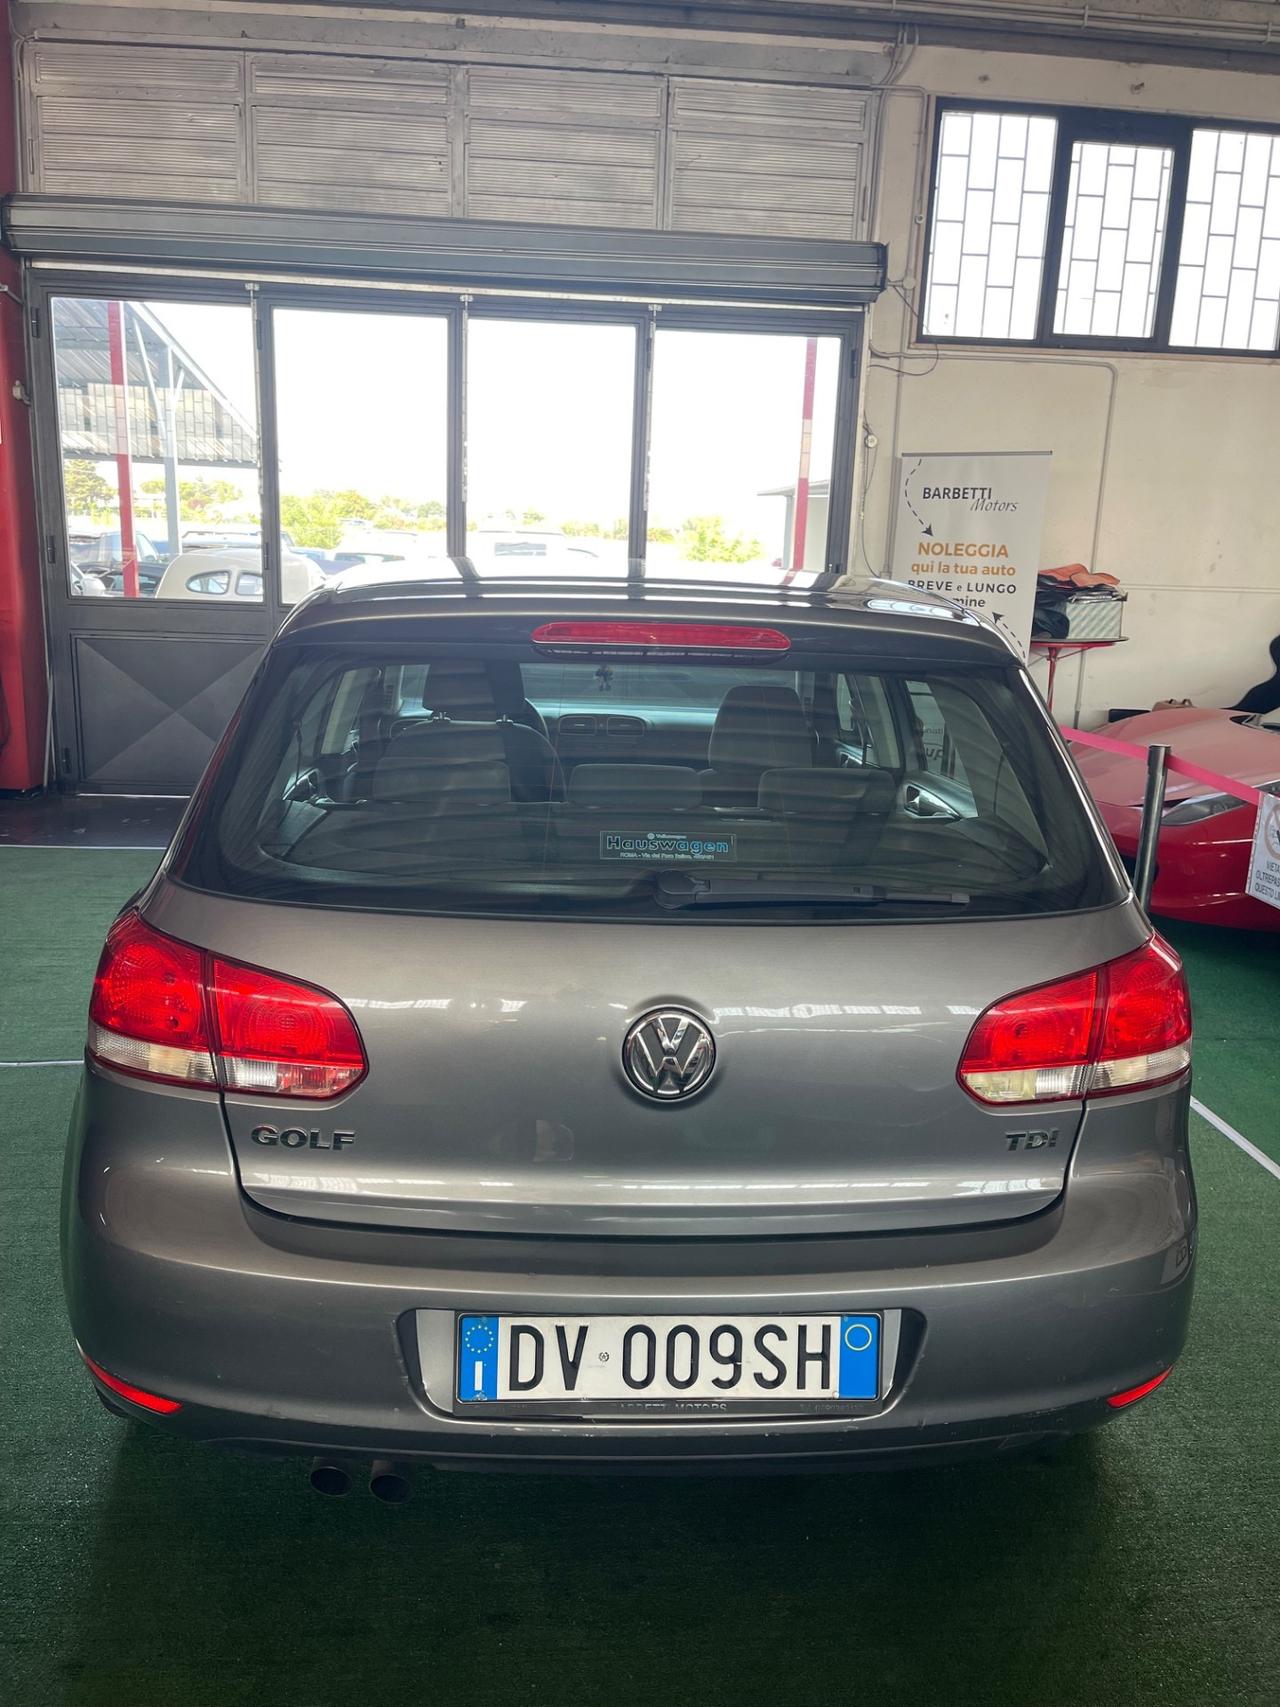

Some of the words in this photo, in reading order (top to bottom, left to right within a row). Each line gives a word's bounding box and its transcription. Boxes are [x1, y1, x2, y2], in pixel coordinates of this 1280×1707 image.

[922, 487, 992, 500] BARBETTI
[970, 499, 1019, 512] Motors
[917, 542, 1009, 558] NOLEGGIA
[911, 562, 935, 575] qui
[938, 562, 950, 574] la
[954, 564, 977, 576] tua
[981, 565, 1016, 576] auto
[908, 580, 953, 591] BREVE
[967, 583, 1016, 594] LUNGO
[606, 835, 729, 854] Hauswagen
[251, 1125, 355, 1150] GOLF
[1005, 1128, 1058, 1151] TDI
[509, 1324, 589, 1391] DV
[622, 1324, 831, 1391] 009SH
